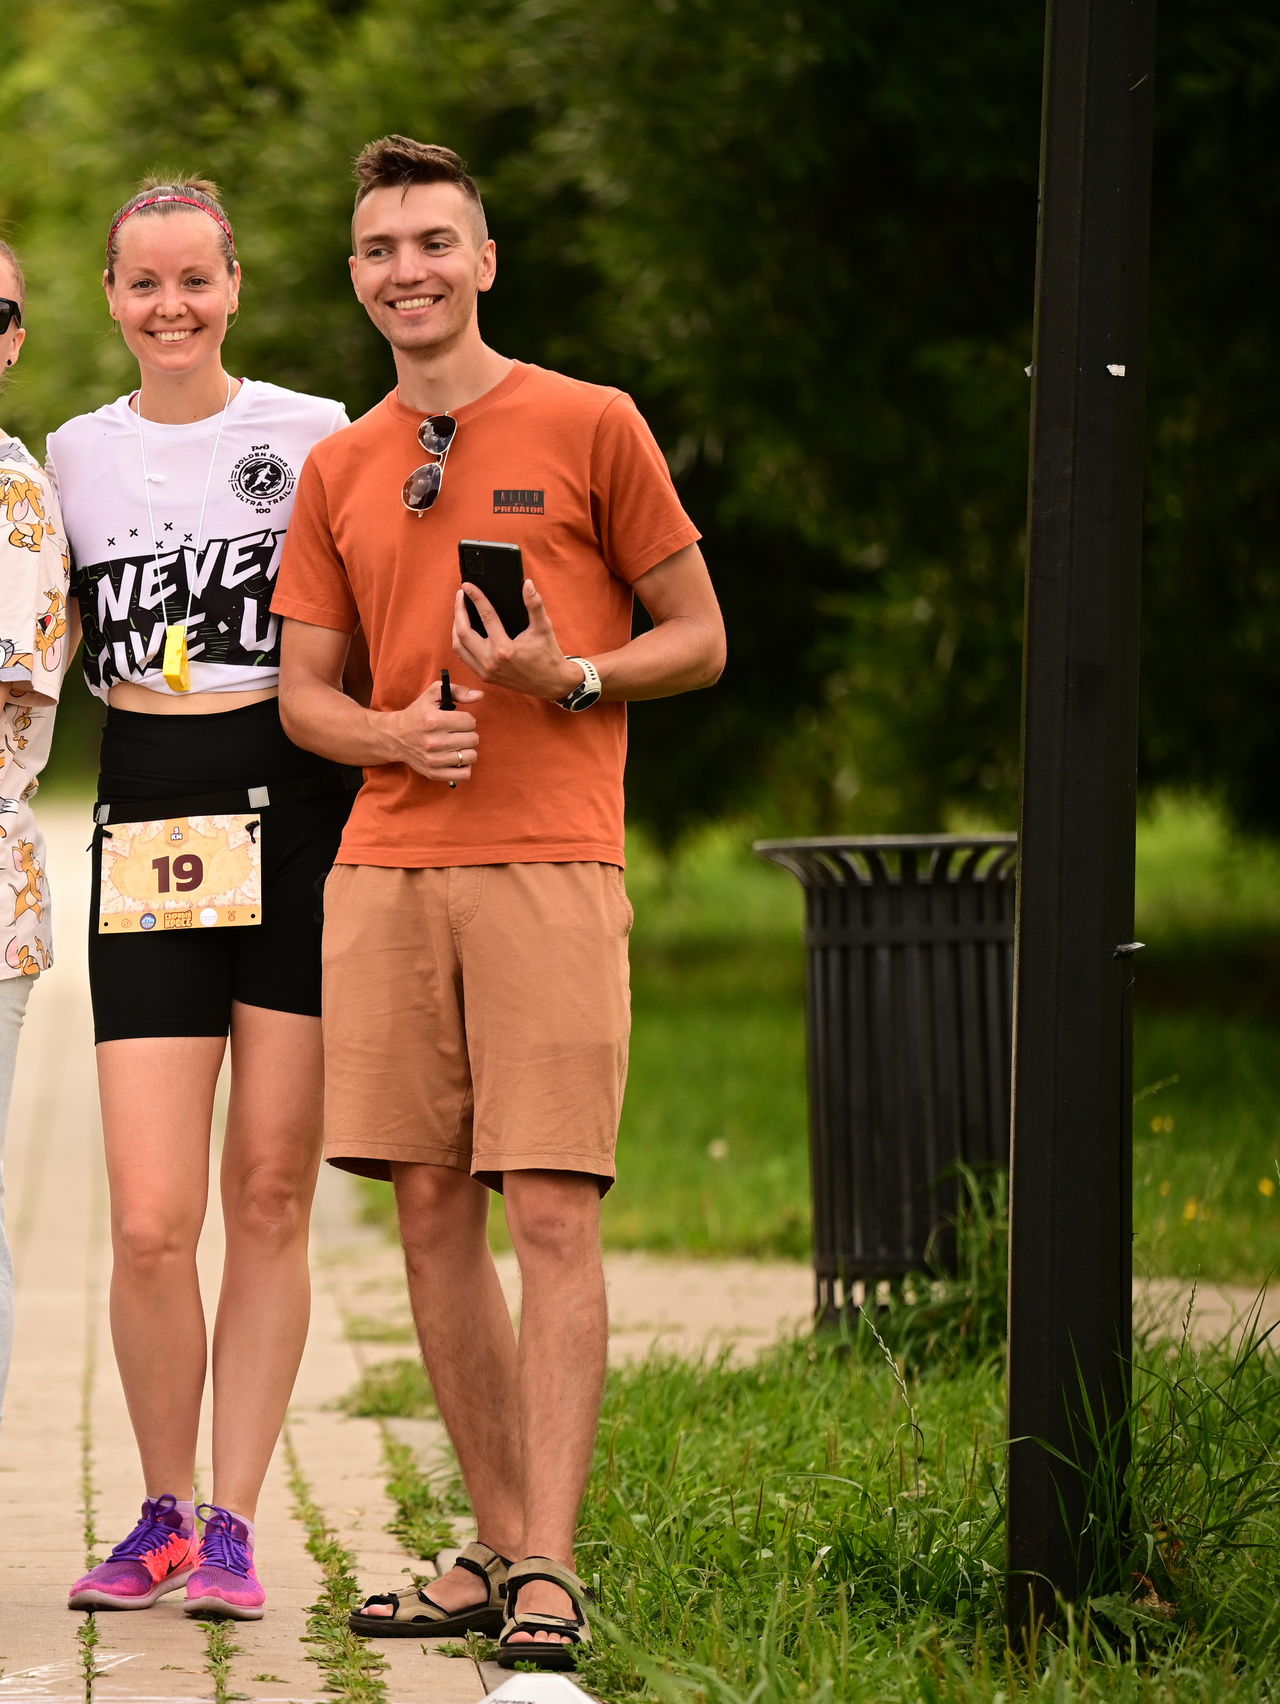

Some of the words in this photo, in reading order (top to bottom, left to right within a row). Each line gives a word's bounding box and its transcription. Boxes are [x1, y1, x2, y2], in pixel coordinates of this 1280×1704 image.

[234, 452, 267, 469] GOLDEN
[269, 453, 288, 468] RING
[236, 492, 263, 507] ULTRA
[267, 491, 292, 506] TRAIL
[494, 505, 544, 514] PREDATOR
[152, 854, 204, 893] 19
